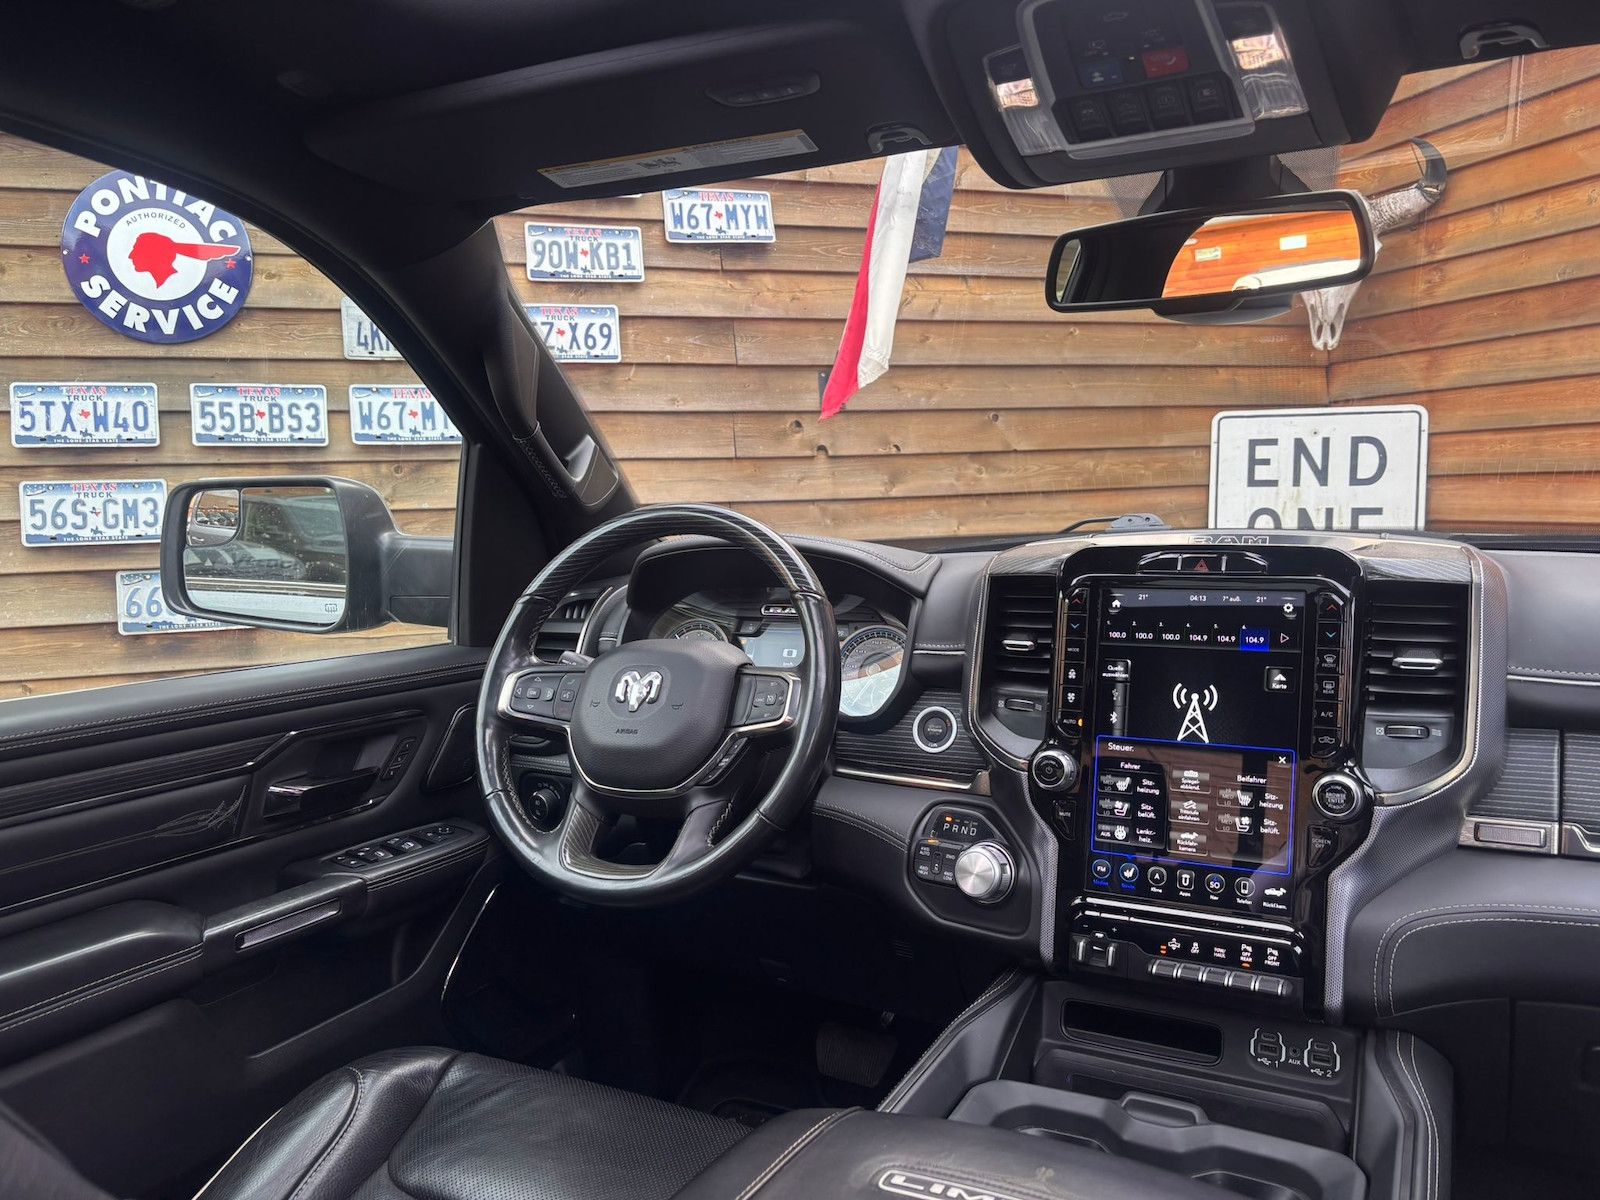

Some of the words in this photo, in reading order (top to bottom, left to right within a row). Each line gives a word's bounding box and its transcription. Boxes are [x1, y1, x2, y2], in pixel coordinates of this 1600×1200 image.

[699, 191, 735, 202] TEXAS
[74, 175, 238, 242] PONTIAC
[126, 211, 186, 230] AUTHORIZED
[670, 202, 713, 230] W67
[724, 203, 769, 230] MYW
[565, 228, 602, 238] TEXAS
[589, 241, 637, 271] KB1
[80, 274, 240, 335] SERVICE
[541, 307, 579, 316] TEXAS
[531, 321, 555, 350] Z
[568, 322, 612, 351] X69
[60, 386, 108, 395] TEXAS
[237, 387, 281, 396] TEXAS
[391, 388, 432, 399] TEXAS
[19, 401, 76, 432] 5TX
[199, 401, 256, 433] 55B
[267, 402, 320, 433] BS3
[358, 401, 407, 431] W67
[1247, 436, 1388, 488] END
[72, 483, 118, 492] TEXAS
[29, 498, 88, 531] 56S
[102, 497, 159, 530] GM3
[1191, 535, 1270, 545] RAM
[126, 586, 178, 618] 66
[1189, 594, 1207, 602] 04:13
[1108, 631, 1127, 639] 100.0
[1135, 632, 1153, 640] 100.0
[1162, 633, 1181, 641] 100.0
[1189, 633, 1208, 642] 104.9
[1217, 635, 1236, 643] 104.9
[1245, 636, 1265, 644] 104.9
[1272, 682, 1287, 690] Karte
[1107, 742, 1135, 751] Steuer.
[1120, 761, 1141, 770] Fahrer
[1142, 778, 1155, 786] Sitz-
[1236, 774, 1267, 784] Beifahrer
[1136, 786, 1160, 796] heizung
[1264, 792, 1279, 800] Sitz-
[1140, 803, 1154, 811] Sitz-
[1259, 800, 1284, 810] heizung
[1263, 818, 1278, 826] Sitz-
[1209, 881, 1221, 889] SO
[1288, 1058, 1301, 1066] AUX
[1326, 1070, 1333, 1078] 2
